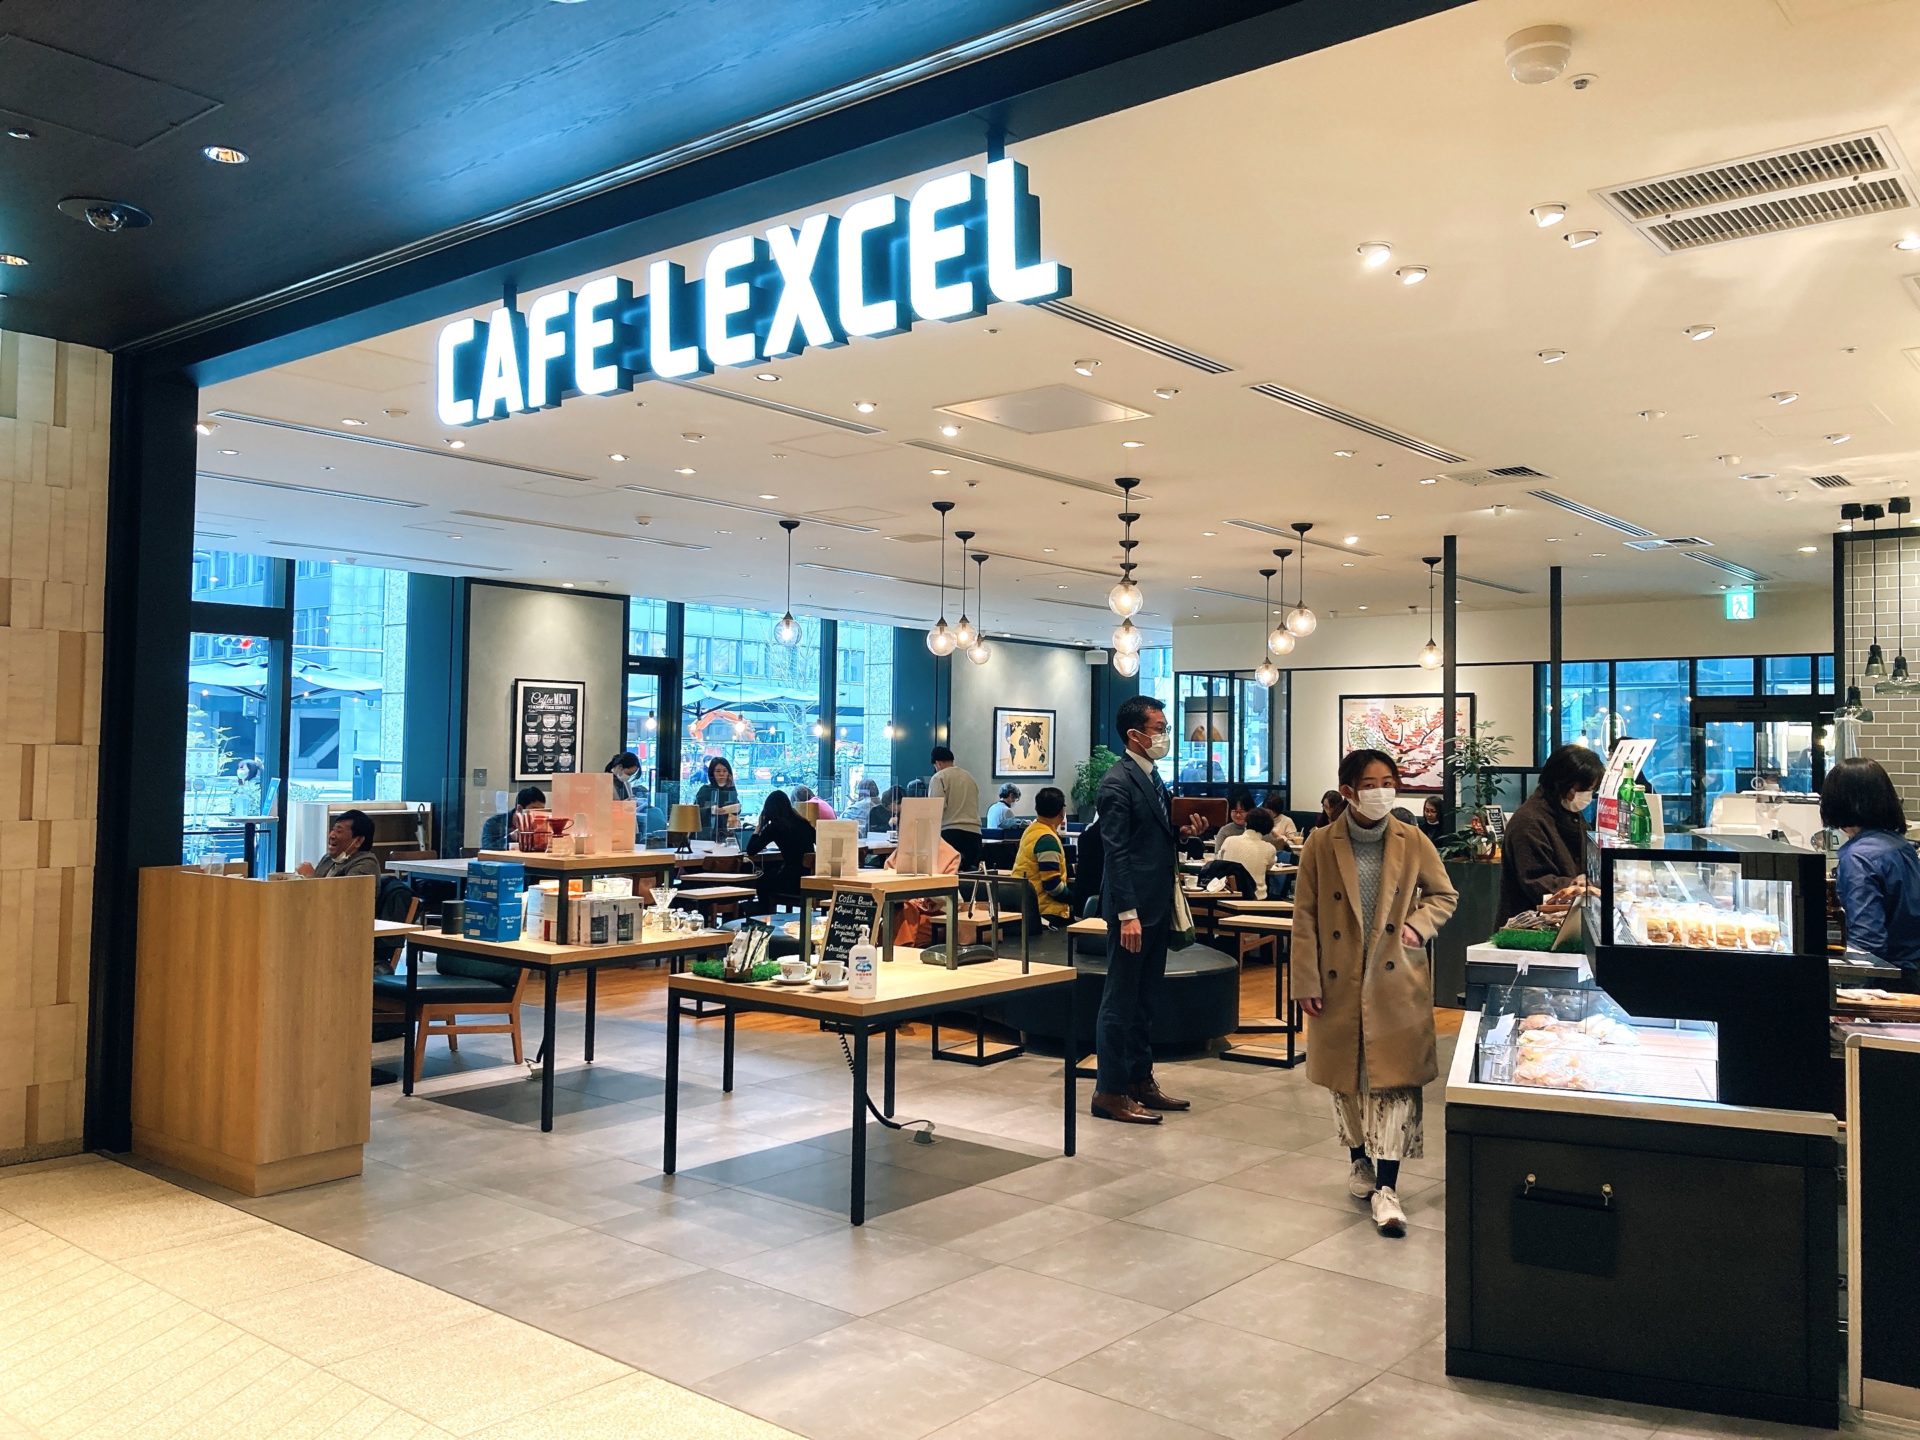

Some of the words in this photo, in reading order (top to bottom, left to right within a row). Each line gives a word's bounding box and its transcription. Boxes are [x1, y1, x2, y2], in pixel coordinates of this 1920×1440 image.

[437, 274, 622, 426] CAFE
[648, 156, 1062, 380] LEXCEL
[531, 691, 554, 707] Coffee
[554, 693, 571, 705] MENU
[839, 894, 856, 903] Coffee
